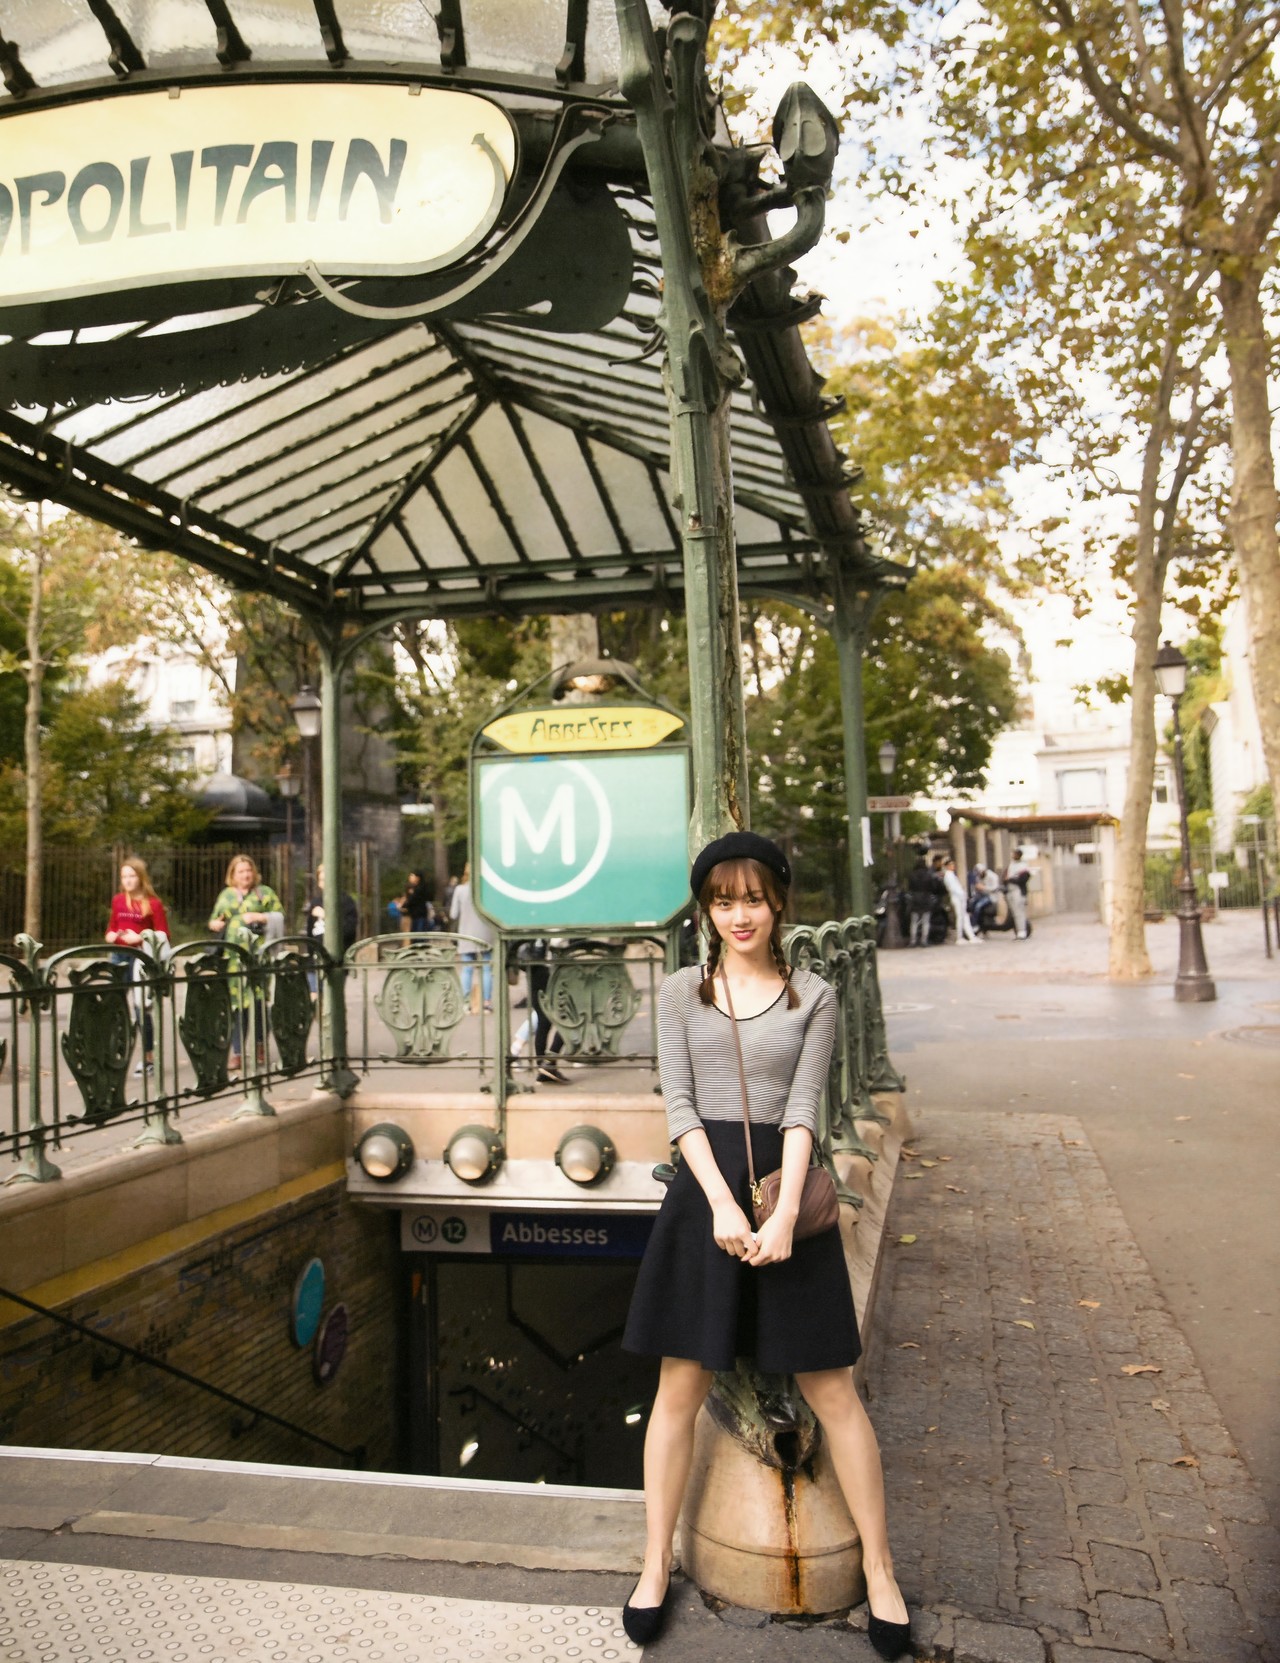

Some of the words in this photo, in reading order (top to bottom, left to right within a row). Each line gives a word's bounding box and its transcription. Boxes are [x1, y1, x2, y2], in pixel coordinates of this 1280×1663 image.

[0, 137, 408, 256] POLITAIN
[498, 783, 576, 868] M
[417, 1222, 433, 1238] M
[443, 1222, 464, 1240] 12
[502, 1222, 609, 1245] Abbesses
